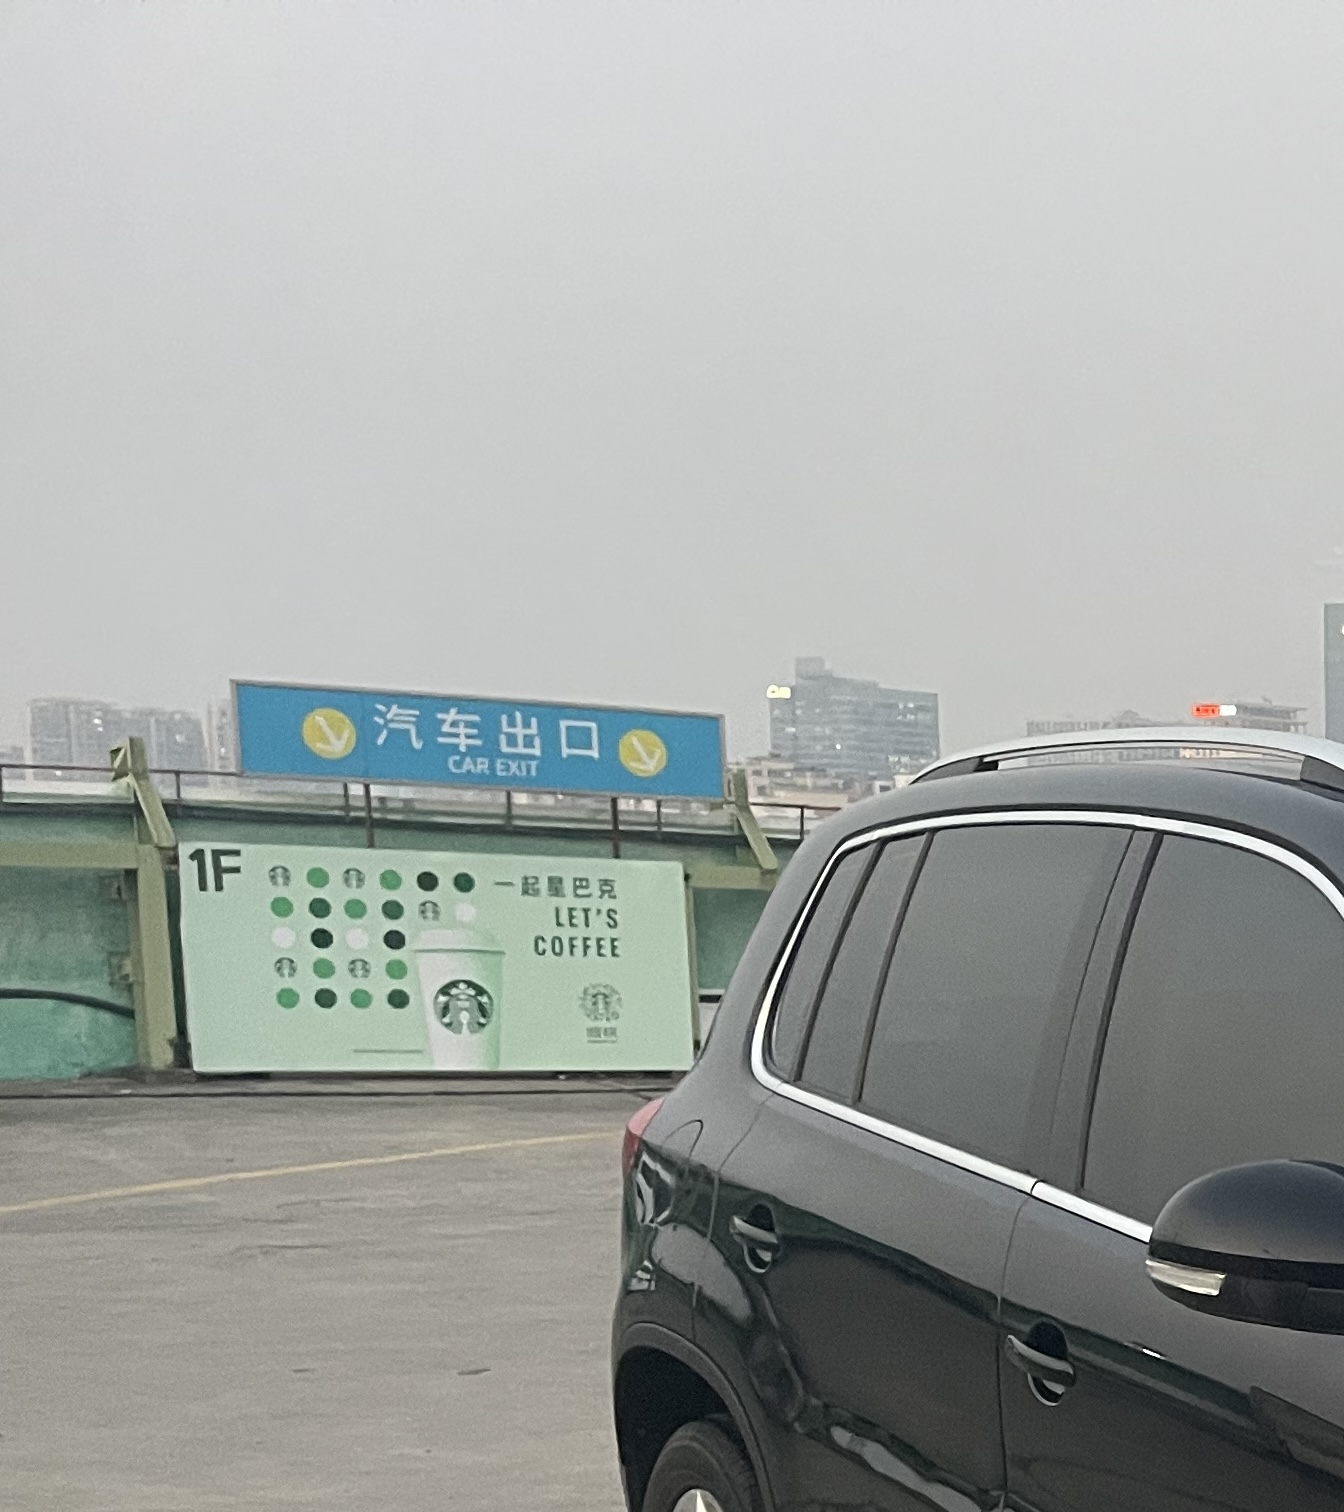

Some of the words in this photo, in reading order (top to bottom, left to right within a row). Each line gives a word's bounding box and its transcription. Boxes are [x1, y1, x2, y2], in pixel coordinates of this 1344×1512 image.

[373, 703, 599, 760] 汽车出口
[448, 755, 489, 775] CAR
[496, 760, 539, 777] EXIT
[188, 848, 241, 892] 1F
[555, 906, 618, 929] LET'S
[533, 935, 620, 958] COFFEE
